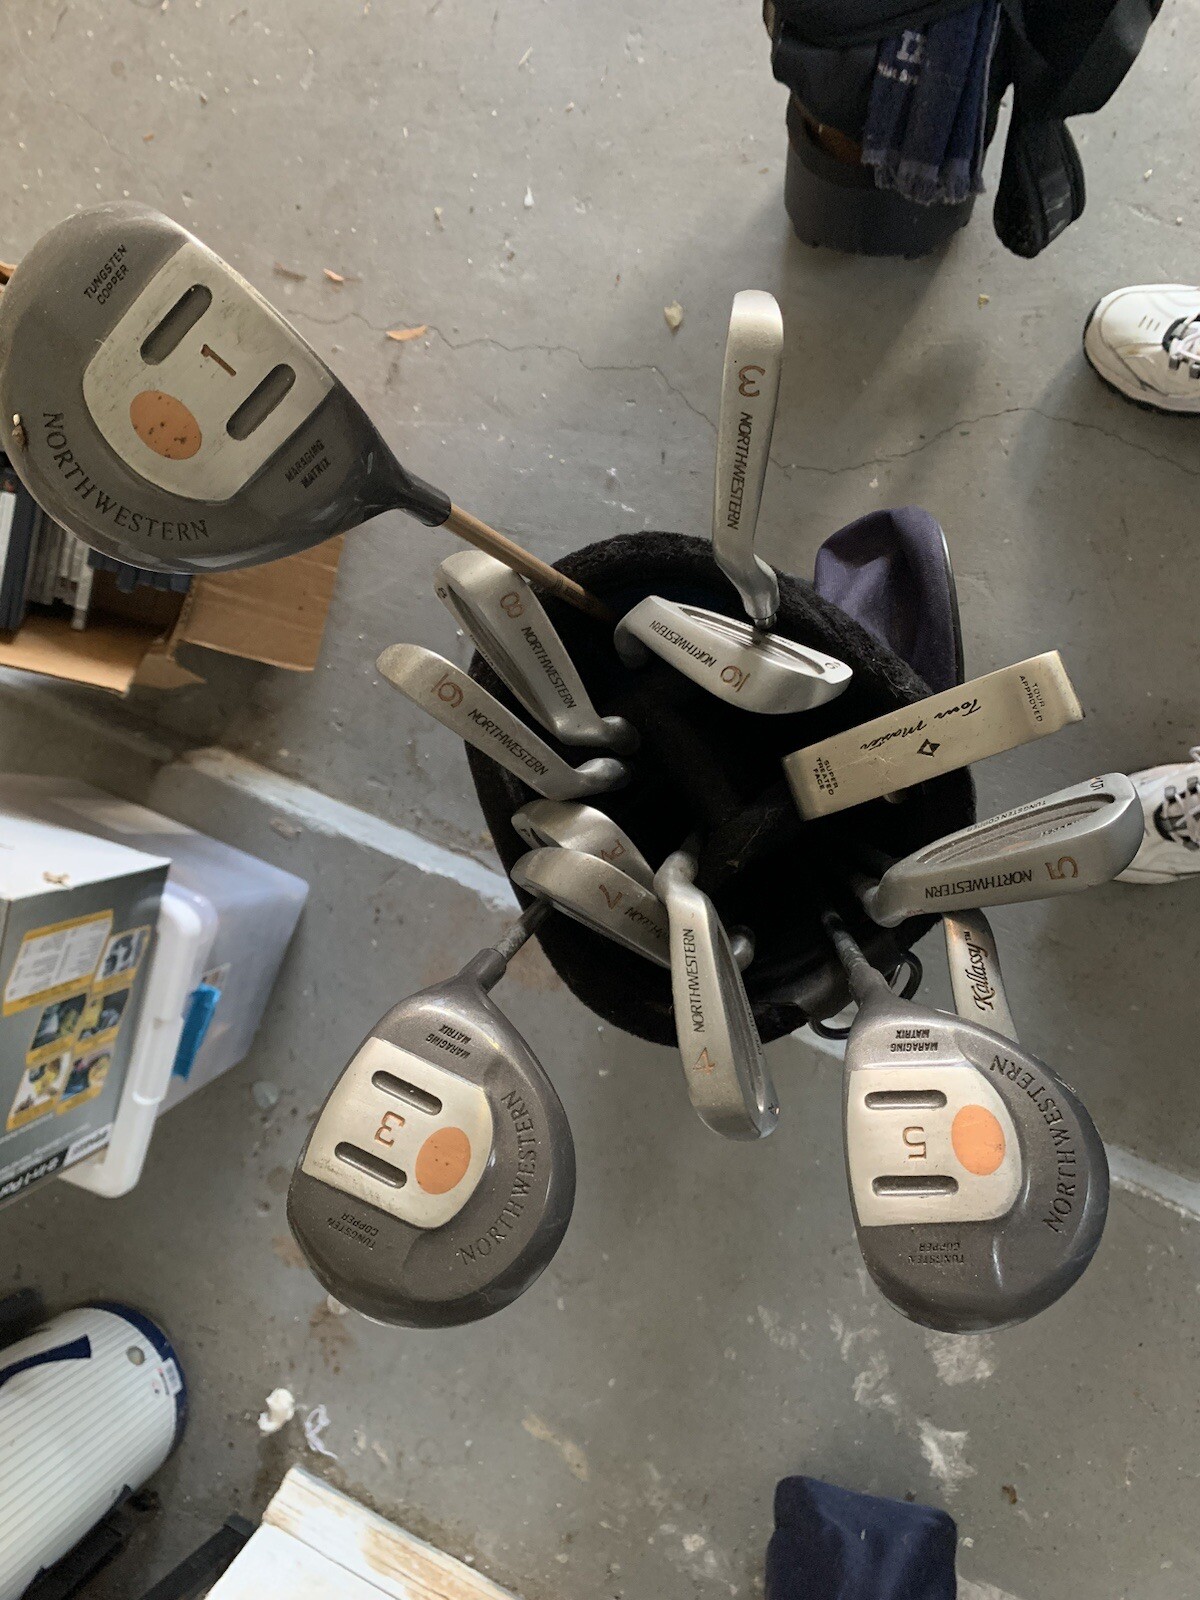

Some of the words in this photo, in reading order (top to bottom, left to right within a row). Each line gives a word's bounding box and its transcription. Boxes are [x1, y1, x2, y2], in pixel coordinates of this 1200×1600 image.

[84, 244, 127, 300] TUNGSTEN
[97, 264, 129, 305] COPPER
[200, 343, 237, 377] 1
[738, 365, 766, 397] 3
[43, 410, 209, 542] NORTHWESTERN
[284, 439, 325, 484] MARAGING
[300, 456, 331, 489] MATRIX
[727, 411, 753, 530] NORTHWESTERN
[499, 591, 525, 619] 8
[649, 620, 717, 668] NORTHWESTERN
[521, 626, 577, 709] NORTHWESTERN
[933, 698, 982, 720] Tour
[1019, 675, 1043, 722] APPROVED
[1032, 683, 1046, 708] TOUR
[467, 708, 549, 776] NORTHWESTERN
[859, 720, 928, 752] Master
[812, 768, 825, 791] FACE
[815, 757, 835, 796] TREATED
[823, 759, 839, 789] SUPER
[925, 869, 1033, 899] NORTHWESTERN
[1045, 856, 1079, 880] 5
[598, 884, 623, 911] 7
[682, 928, 706, 1033] NORTHWESTERN
[425, 1033, 471, 1059] MARAGING
[438, 1024, 472, 1043] MATRIX
[890, 1041, 939, 1053] MARAGING
[895, 1029, 931, 1040] MATRIX
[692, 1047, 716, 1075] 4
[374, 1110, 406, 1148] 3
[902, 1125, 928, 1160] 5
[990, 1054, 1078, 1235] NORTHWESTERN
[457, 1089, 537, 1266] NORTHWESTERN
[327, 1216, 377, 1249] TUNGSTEN
[340, 1212, 379, 1237] COPPER
[918, 1241, 961, 1252] COPPER
